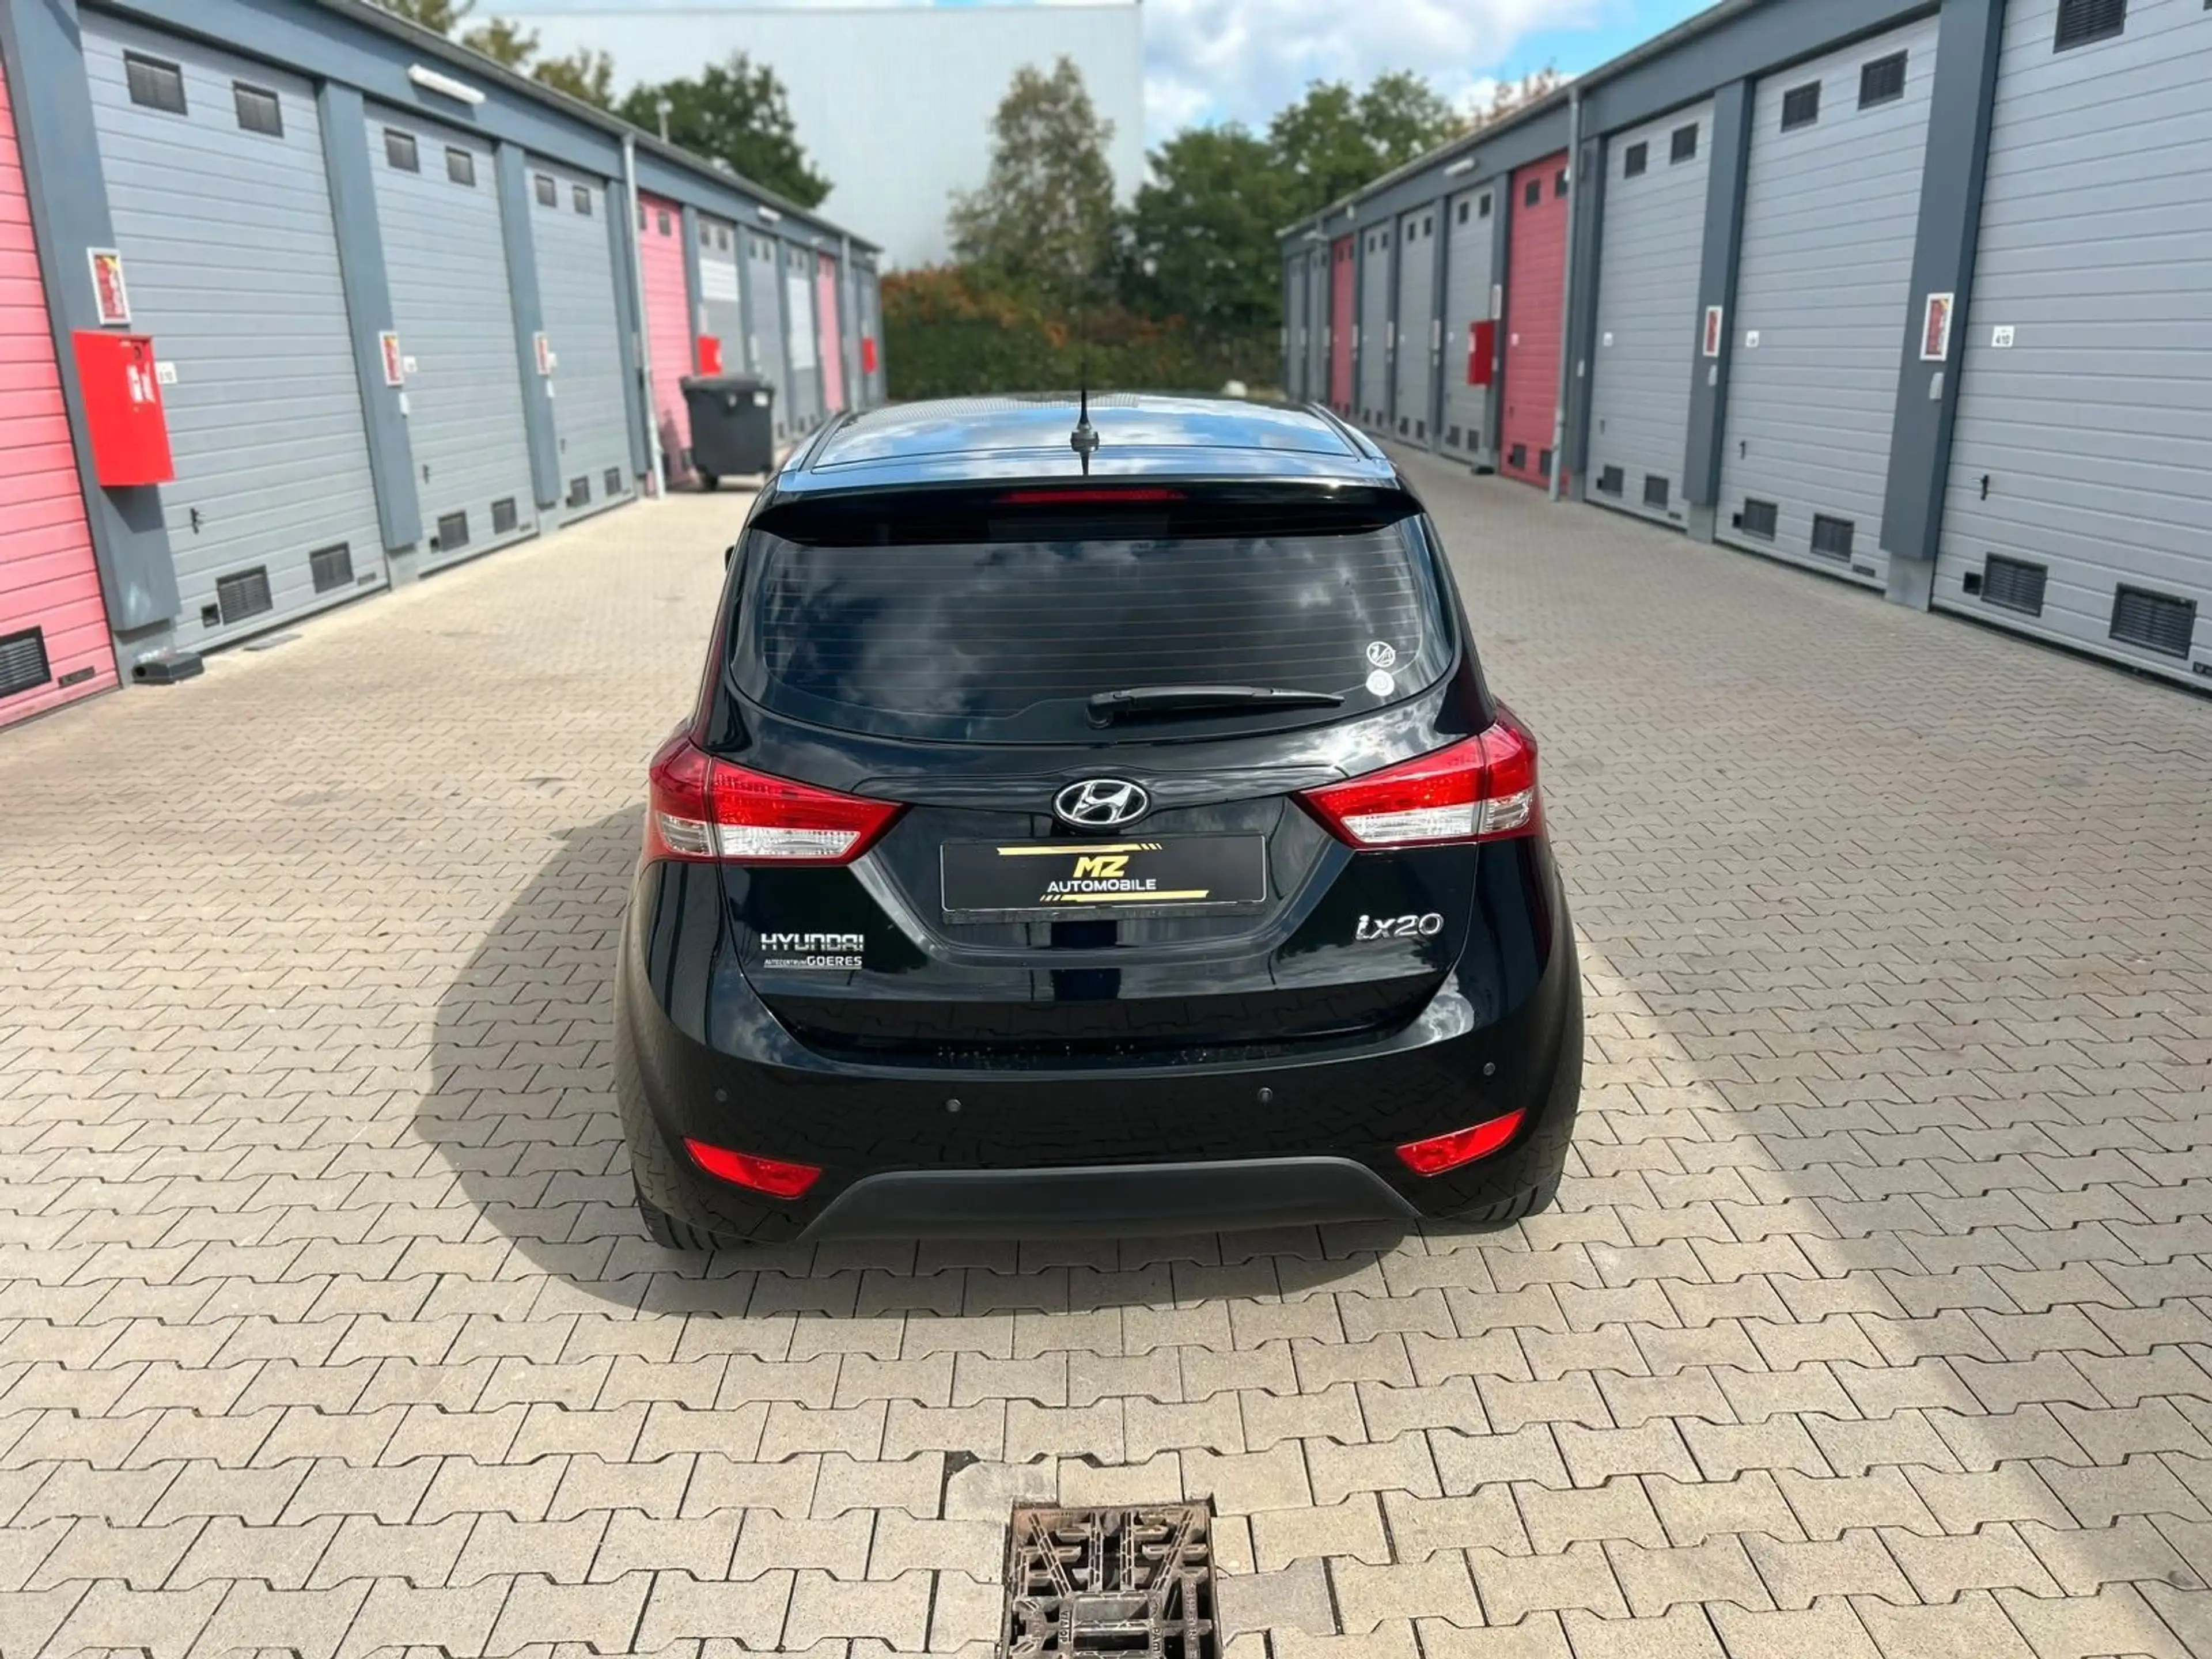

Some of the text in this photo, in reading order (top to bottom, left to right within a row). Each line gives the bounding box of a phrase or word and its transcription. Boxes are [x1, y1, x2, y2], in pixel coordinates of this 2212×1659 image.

[1073, 855, 1129, 878] MZ
[1047, 878, 1157, 893] AUTOMOBILE
[1355, 912, 1444, 940] ix20
[760, 933, 864, 952] HYUNDAI
[806, 955, 863, 967] GOERES
